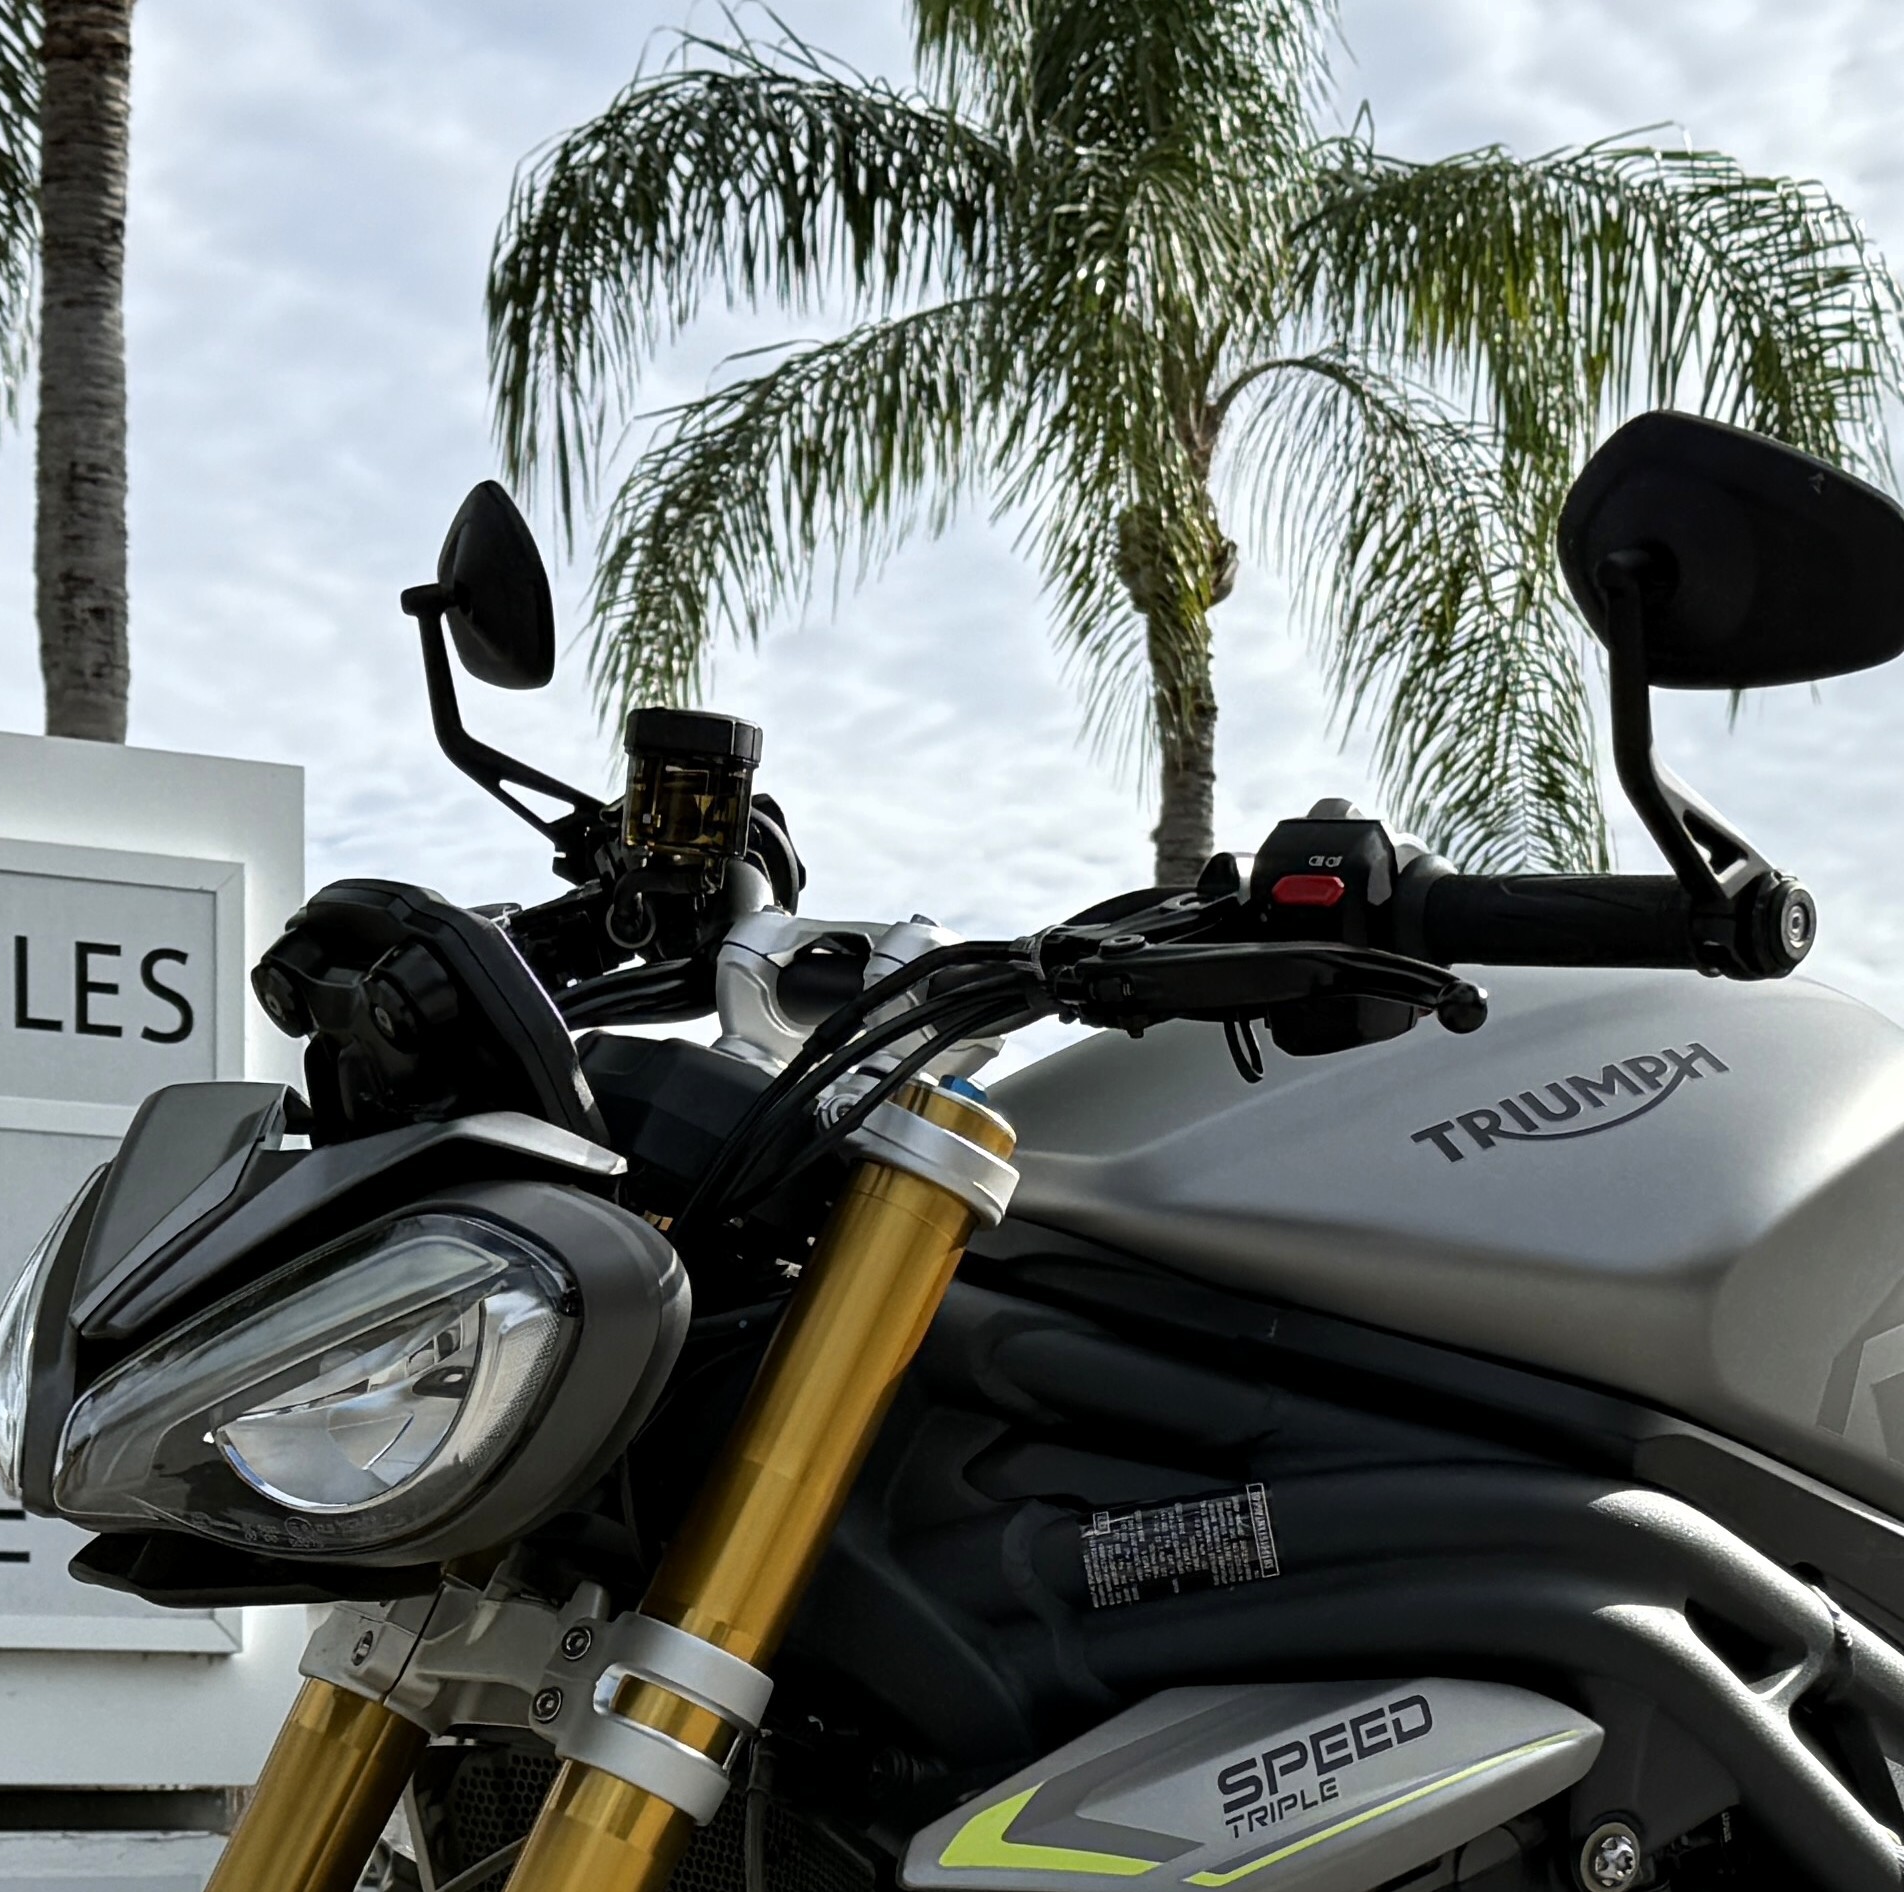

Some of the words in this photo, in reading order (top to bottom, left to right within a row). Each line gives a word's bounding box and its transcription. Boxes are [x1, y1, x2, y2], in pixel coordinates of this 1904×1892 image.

[1409, 1041, 1730, 1164] TRIUMPH
[1217, 1694, 1433, 1815] SPEED
[1225, 1777, 1340, 1839] TRIPLE
